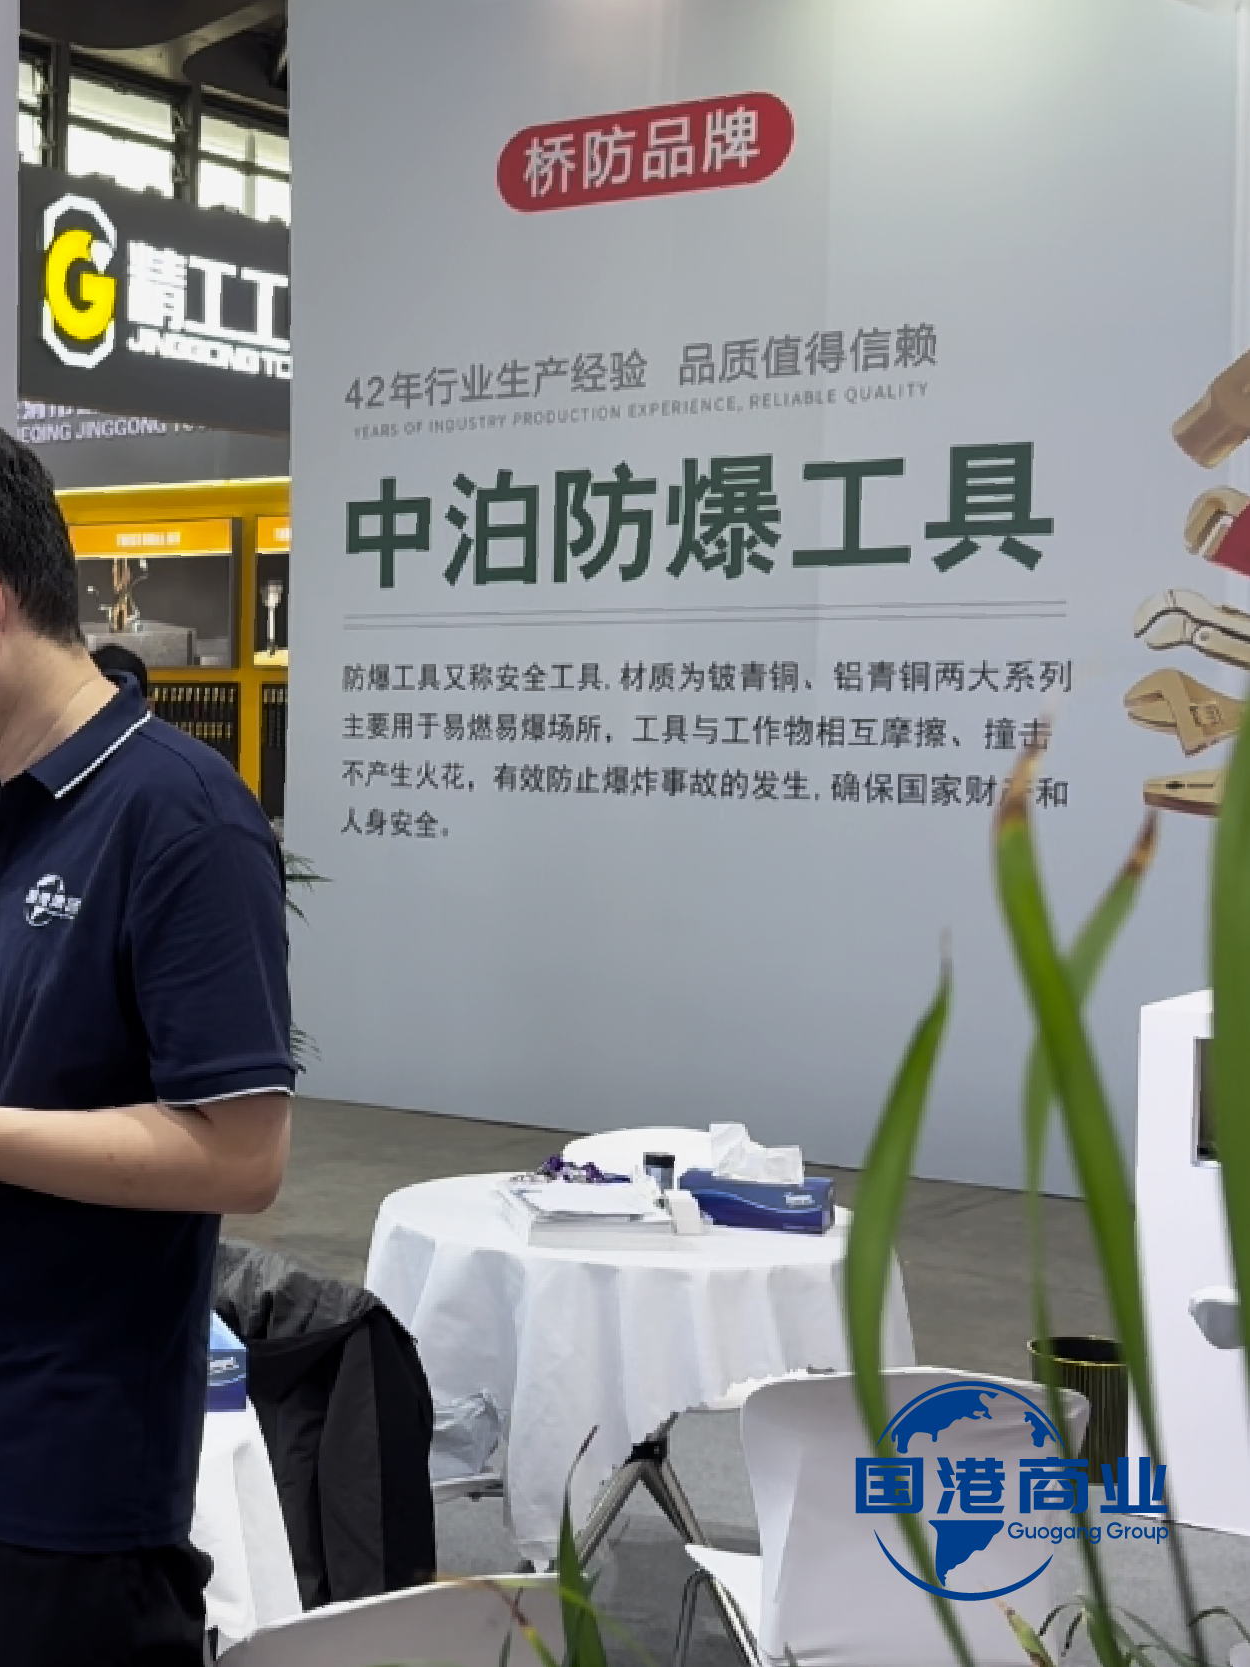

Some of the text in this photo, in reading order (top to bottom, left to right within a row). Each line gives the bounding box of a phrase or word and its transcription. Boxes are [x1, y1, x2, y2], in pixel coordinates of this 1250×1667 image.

[524, 105, 762, 199] 桥防品牌
[126, 326, 261, 374] JINGGONG
[345, 322, 938, 412] 42年行业生产经验 品质值得信赖
[75, 416, 168, 441] JINGGONG
[353, 382, 930, 440] YEARS OF INDUSTRY PRODUCTION EXPERIENCE, RELIABLE QUALITY
[345, 442, 1055, 590] 中泊防爆工具
[341, 760, 1070, 807] 不产生火花，有效防止爆炸事故的发生,确保国家财和
[341, 808, 450, 837] 人身安全。
